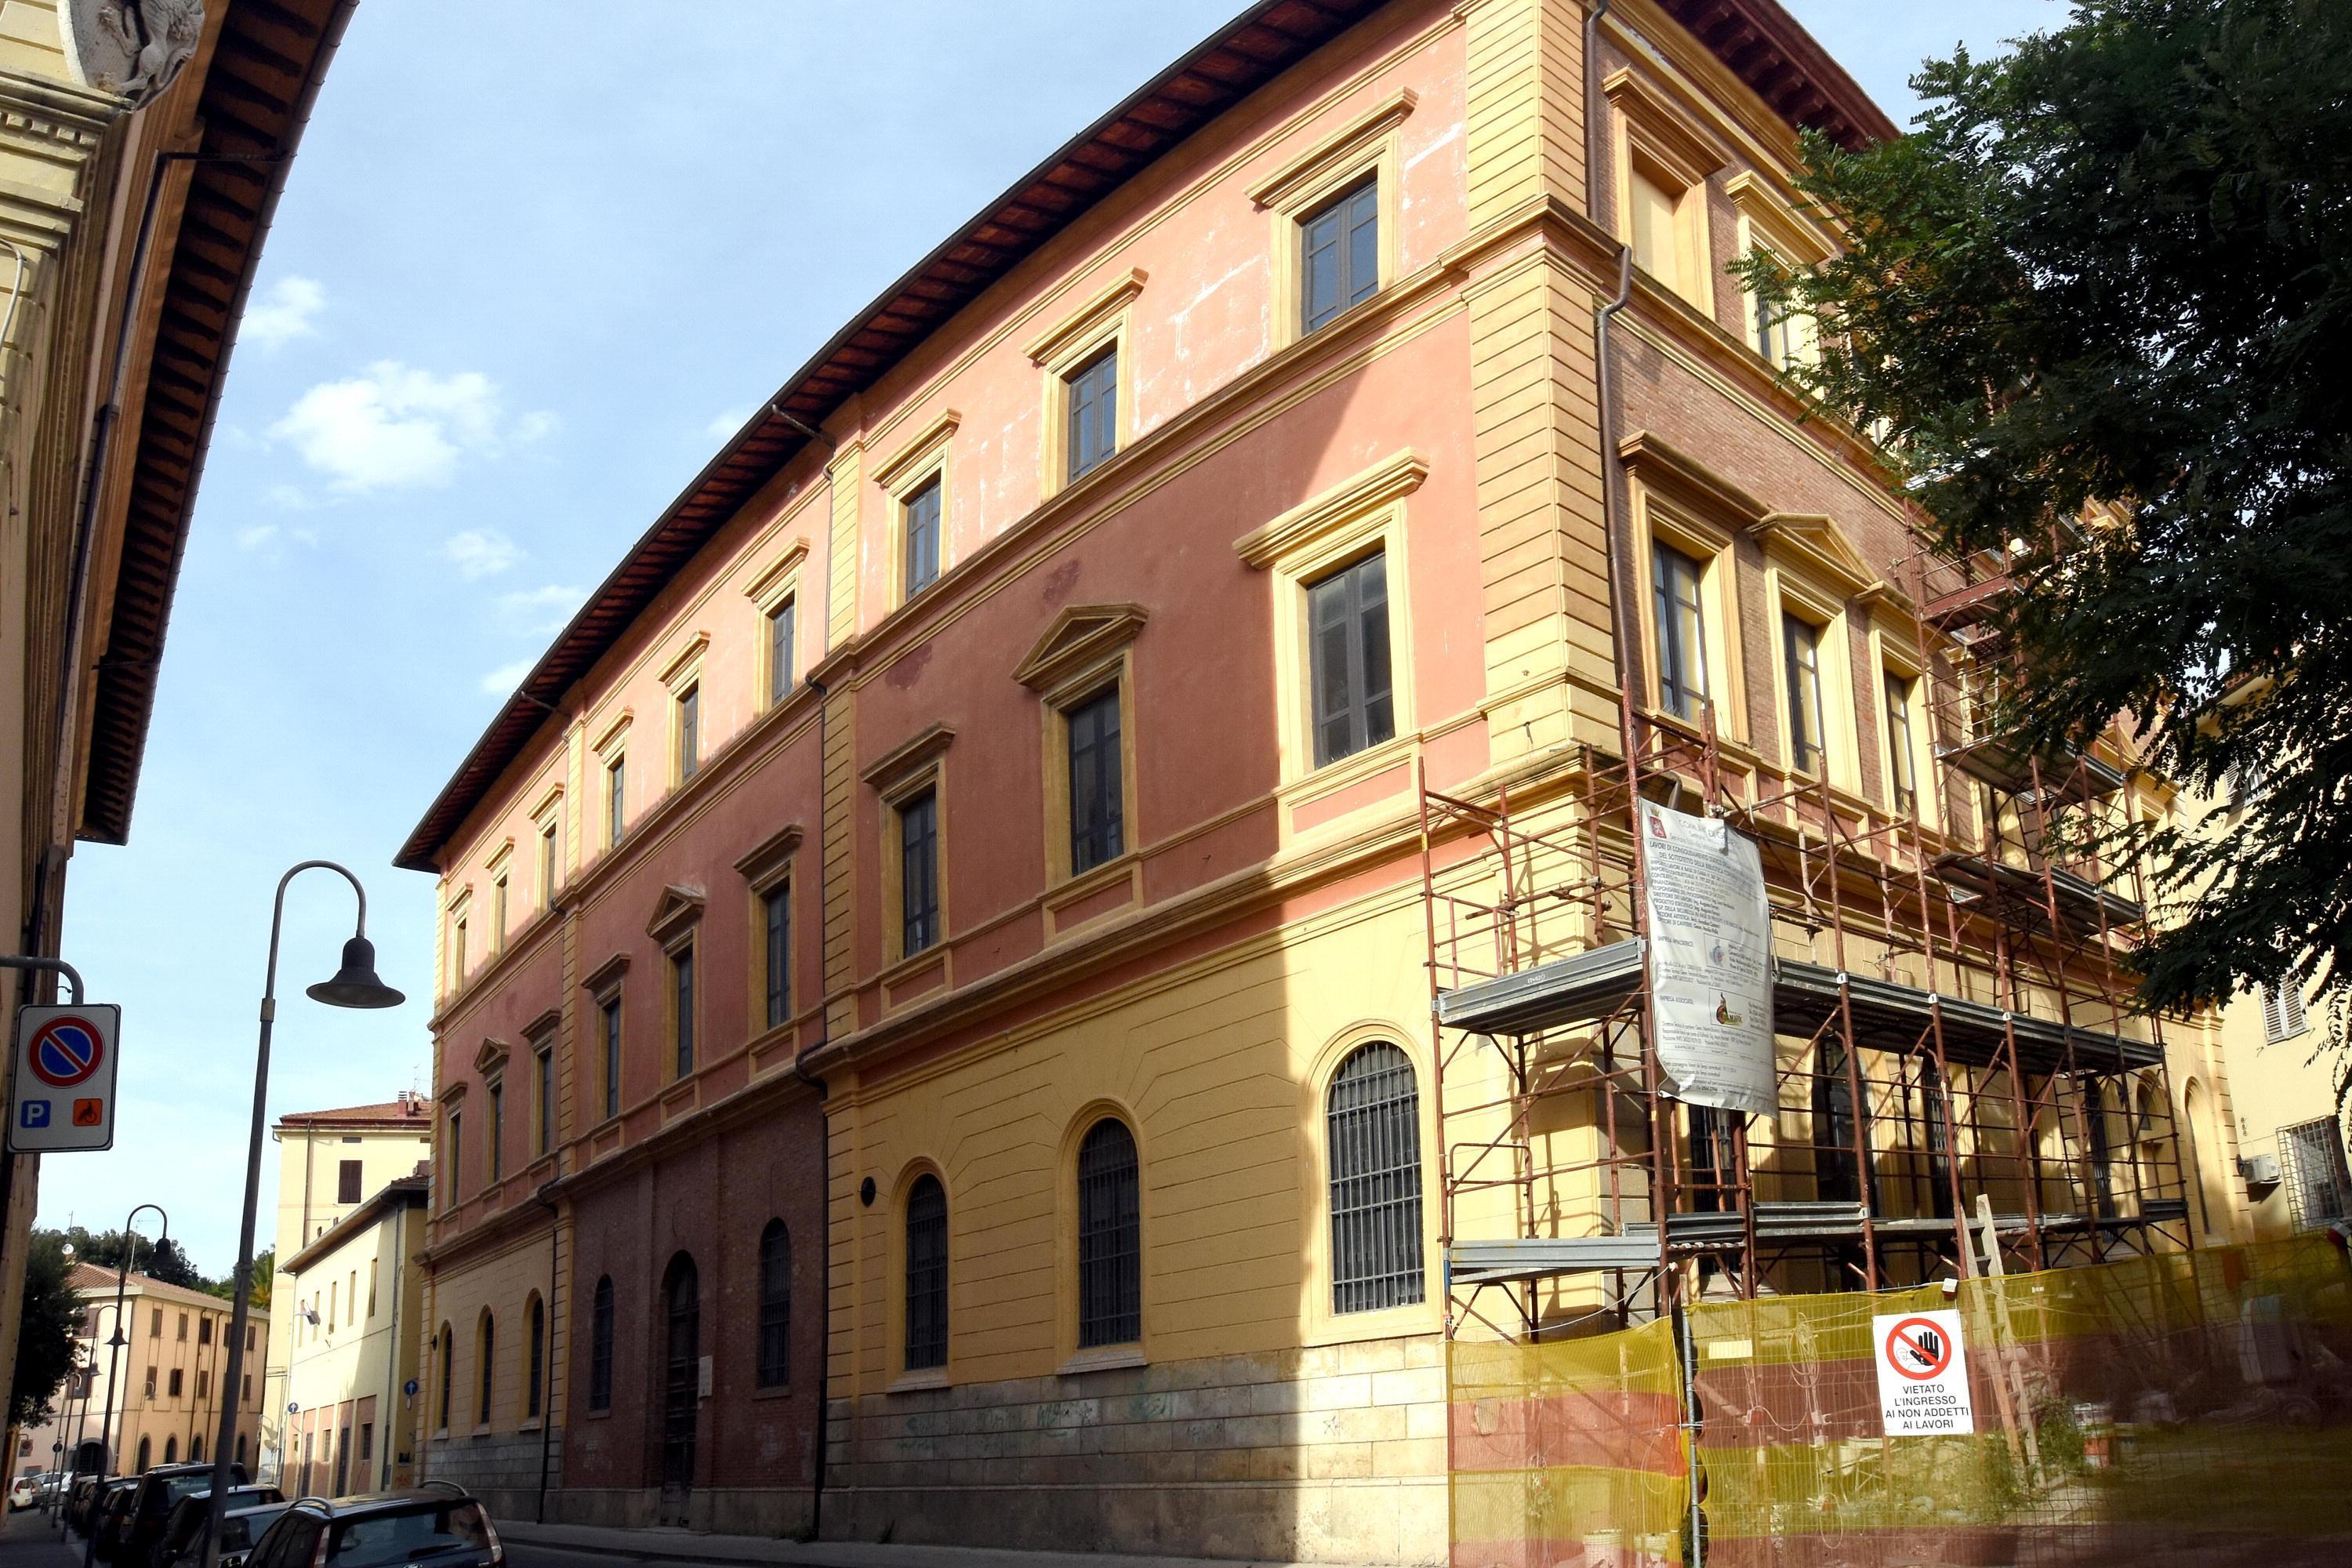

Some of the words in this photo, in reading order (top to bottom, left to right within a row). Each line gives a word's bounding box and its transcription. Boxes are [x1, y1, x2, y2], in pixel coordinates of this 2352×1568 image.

[1650, 841, 1666, 851] LAVORI
[27, 1104, 45, 1125] P
[1903, 1385, 1944, 1394] VIETATO
[1895, 1396, 1956, 1406] L'INGRESSO
[1886, 1410, 1895, 1418] AI
[1898, 1409, 1921, 1417] NON
[1925, 1407, 1969, 1417] ADDETTI
[1916, 1420, 1954, 1429] LAVORI
